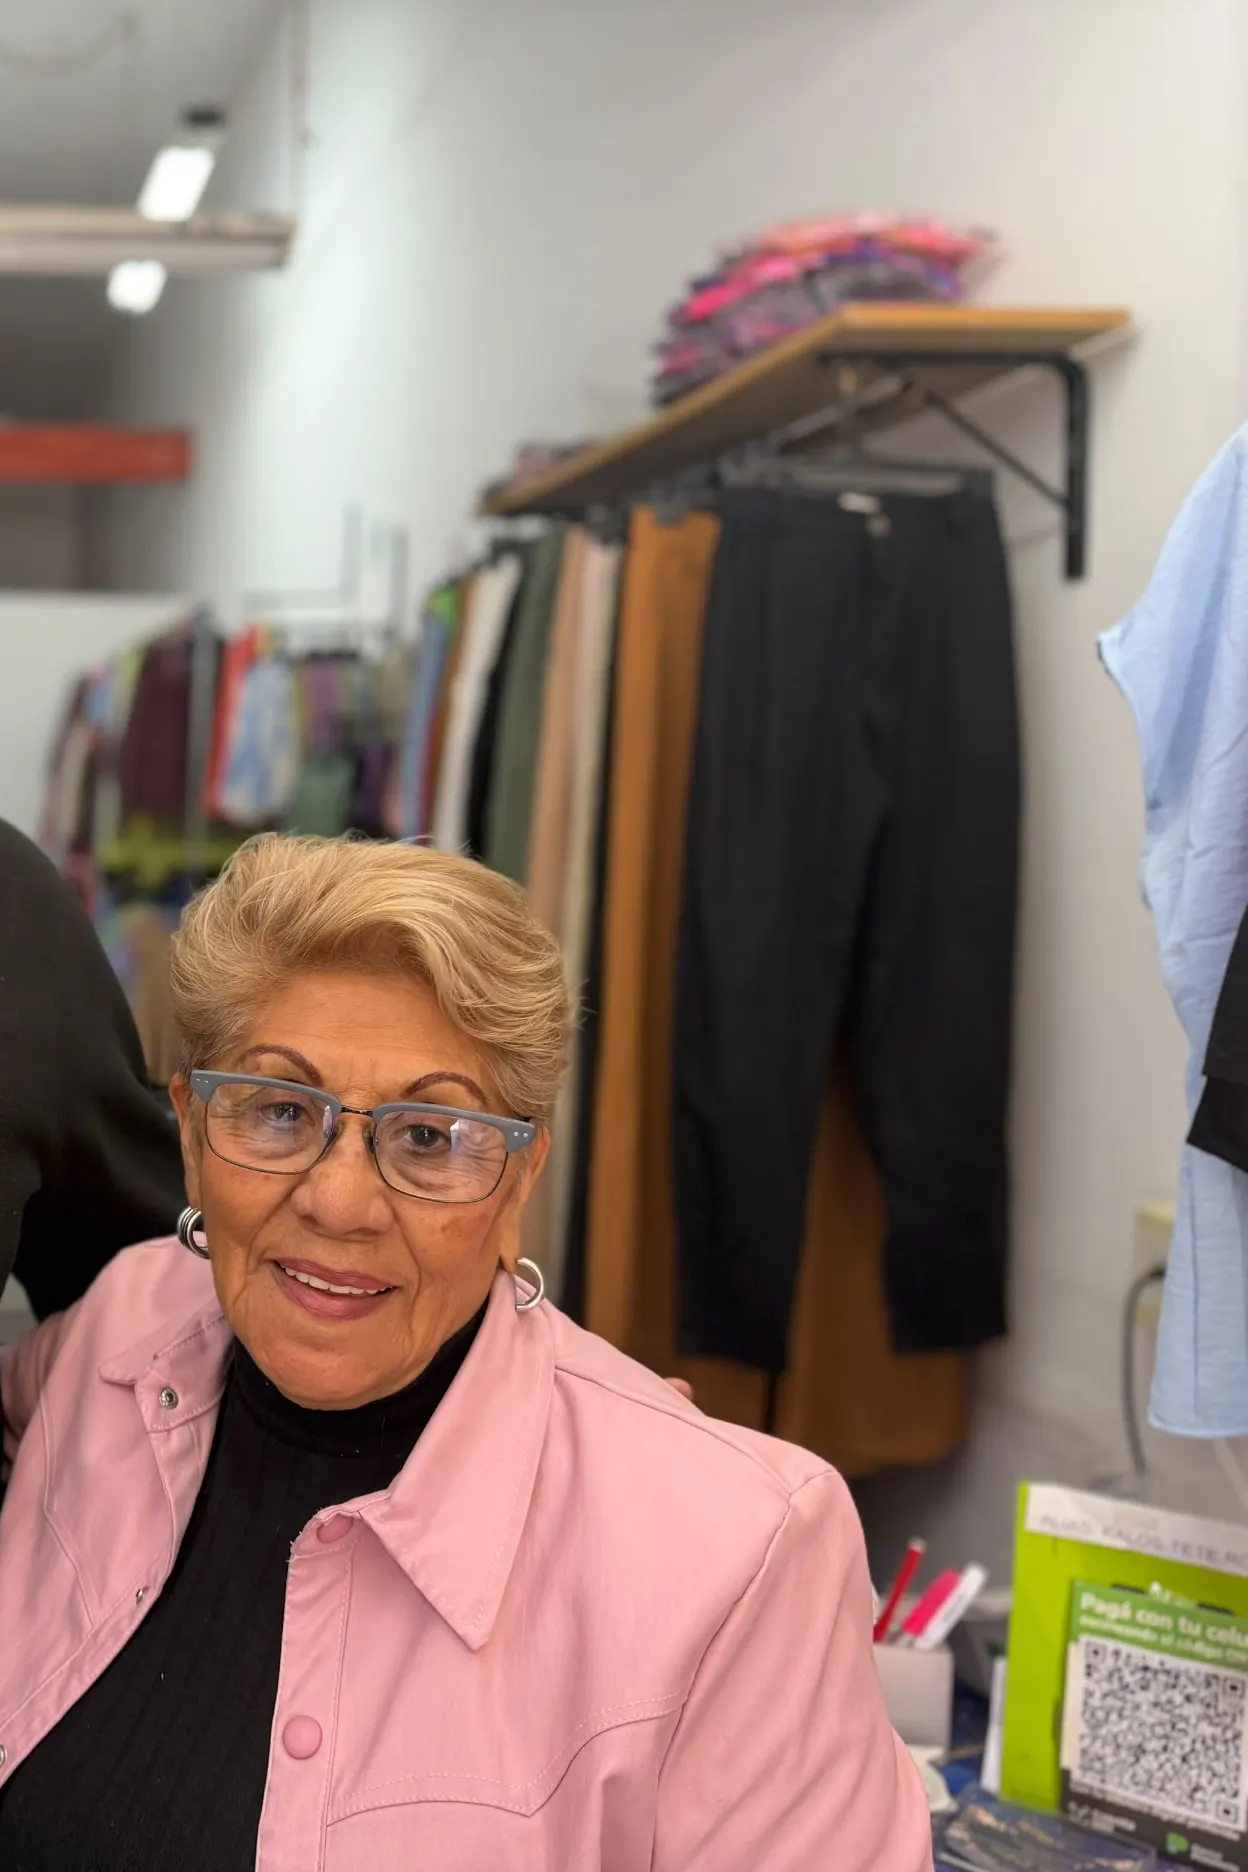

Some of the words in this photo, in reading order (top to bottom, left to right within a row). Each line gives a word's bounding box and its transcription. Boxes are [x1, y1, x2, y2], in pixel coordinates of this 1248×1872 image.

[1081, 1592, 1132, 1622] Pagá
[1135, 1608, 1174, 1631] con
[1178, 1615, 1202, 1636] tu
